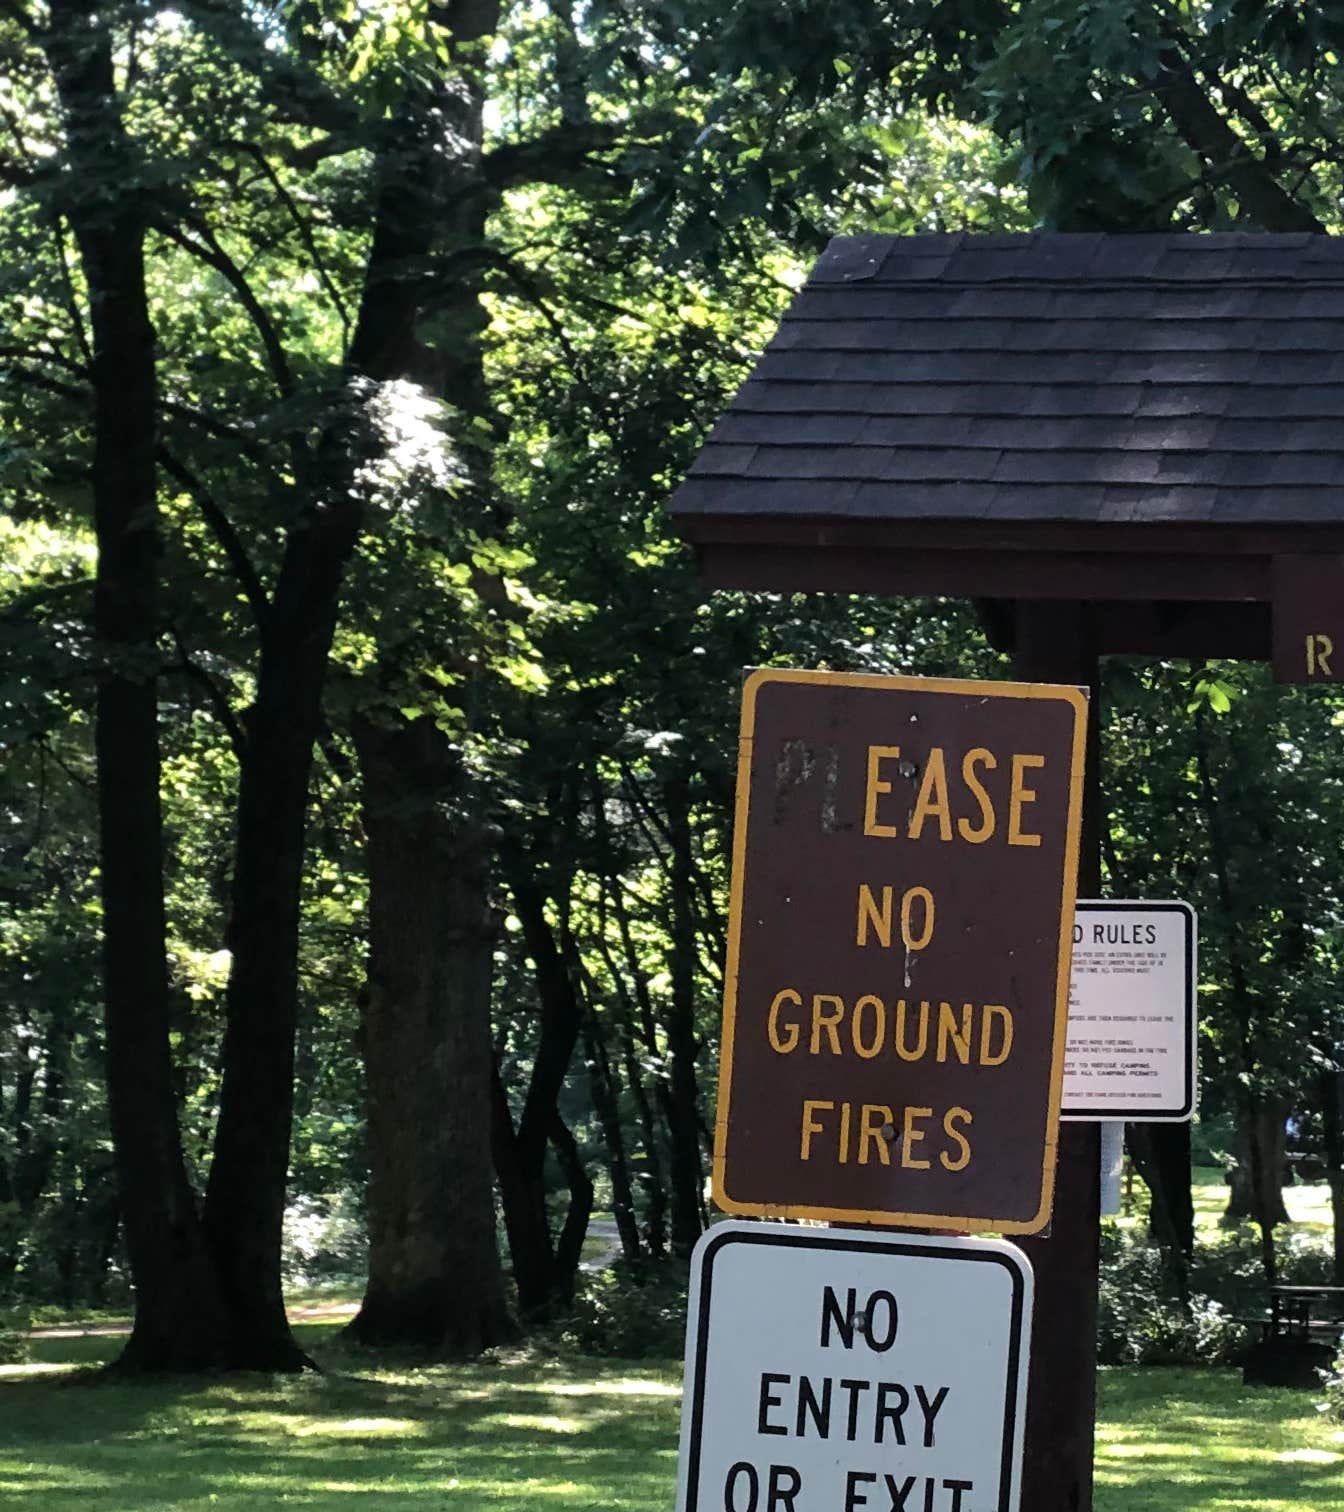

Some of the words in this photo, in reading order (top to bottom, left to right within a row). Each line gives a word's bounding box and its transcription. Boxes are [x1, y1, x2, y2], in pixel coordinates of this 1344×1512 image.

[856, 884, 936, 951] NO
[1093, 924, 1157, 944] RULES
[767, 988, 1014, 1066] GROUND
[800, 1100, 973, 1171] FIRES
[820, 1286, 899, 1353] NO
[757, 1372, 950, 1448] ENTRY
